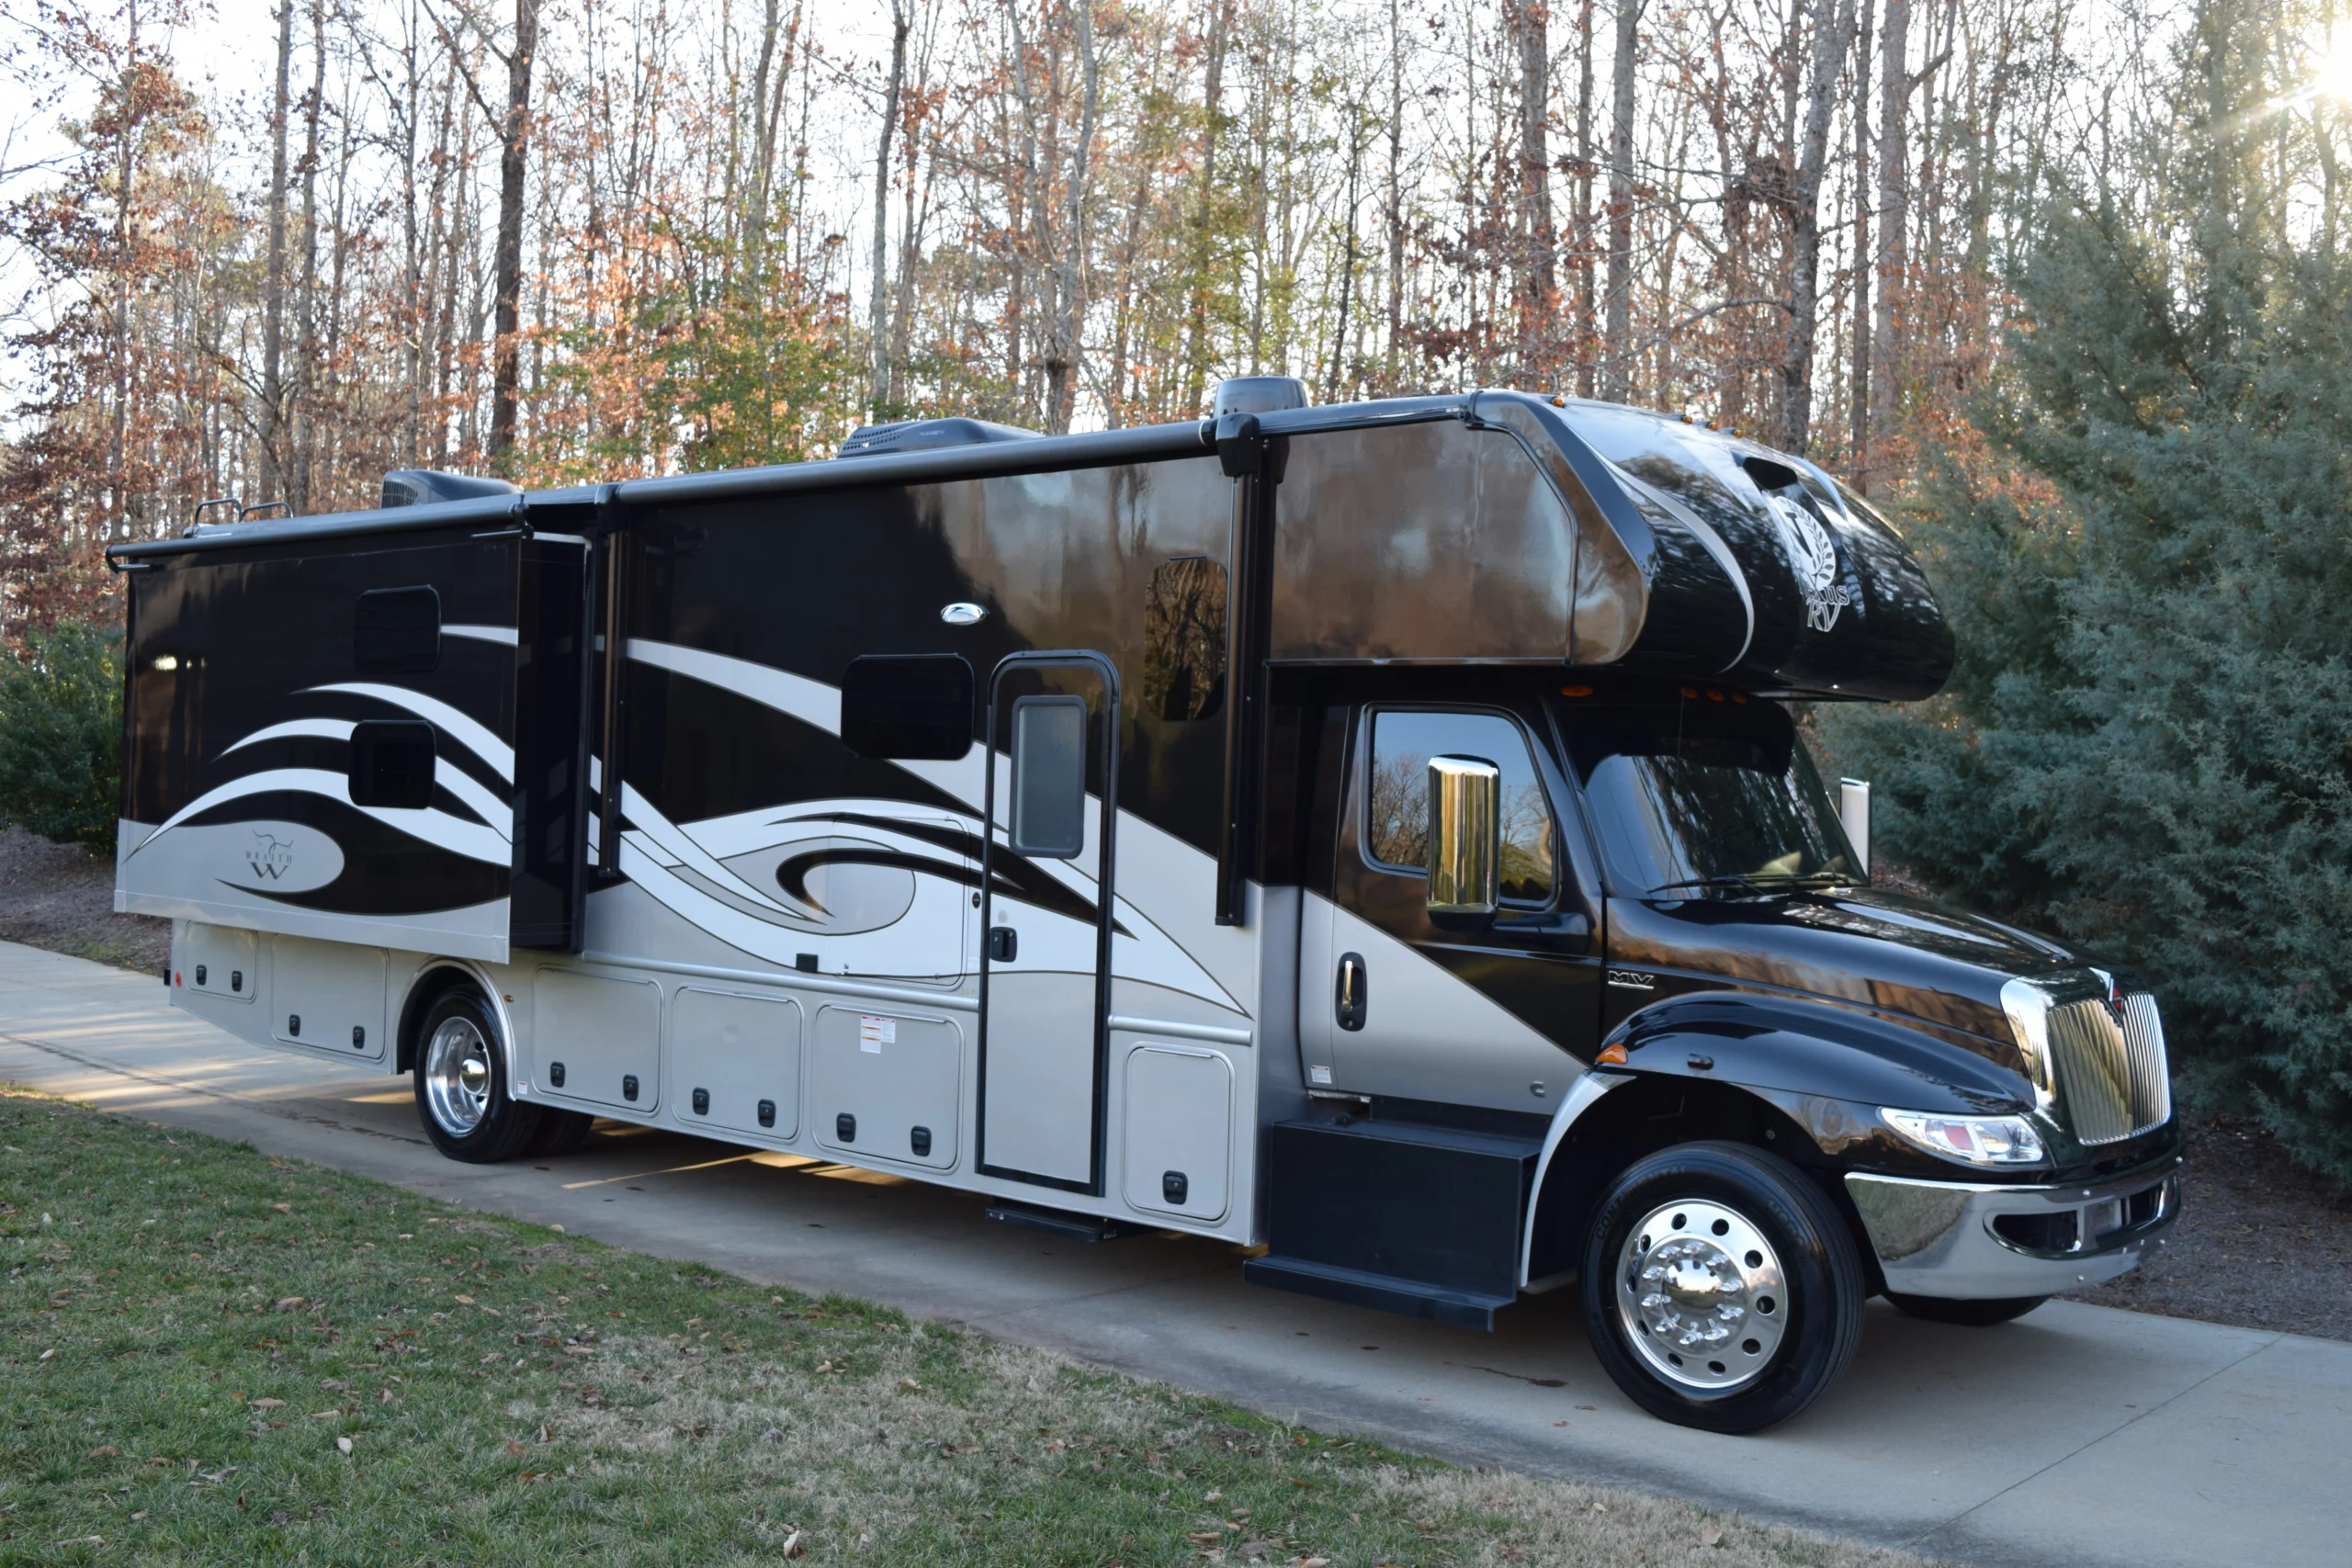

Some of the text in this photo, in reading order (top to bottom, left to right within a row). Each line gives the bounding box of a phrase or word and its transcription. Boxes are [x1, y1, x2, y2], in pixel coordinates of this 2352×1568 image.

[1806, 596, 1841, 633] RV
[244, 850, 293, 864] WRAITH
[248, 861, 290, 881] W
[1608, 970, 1655, 986] MV
